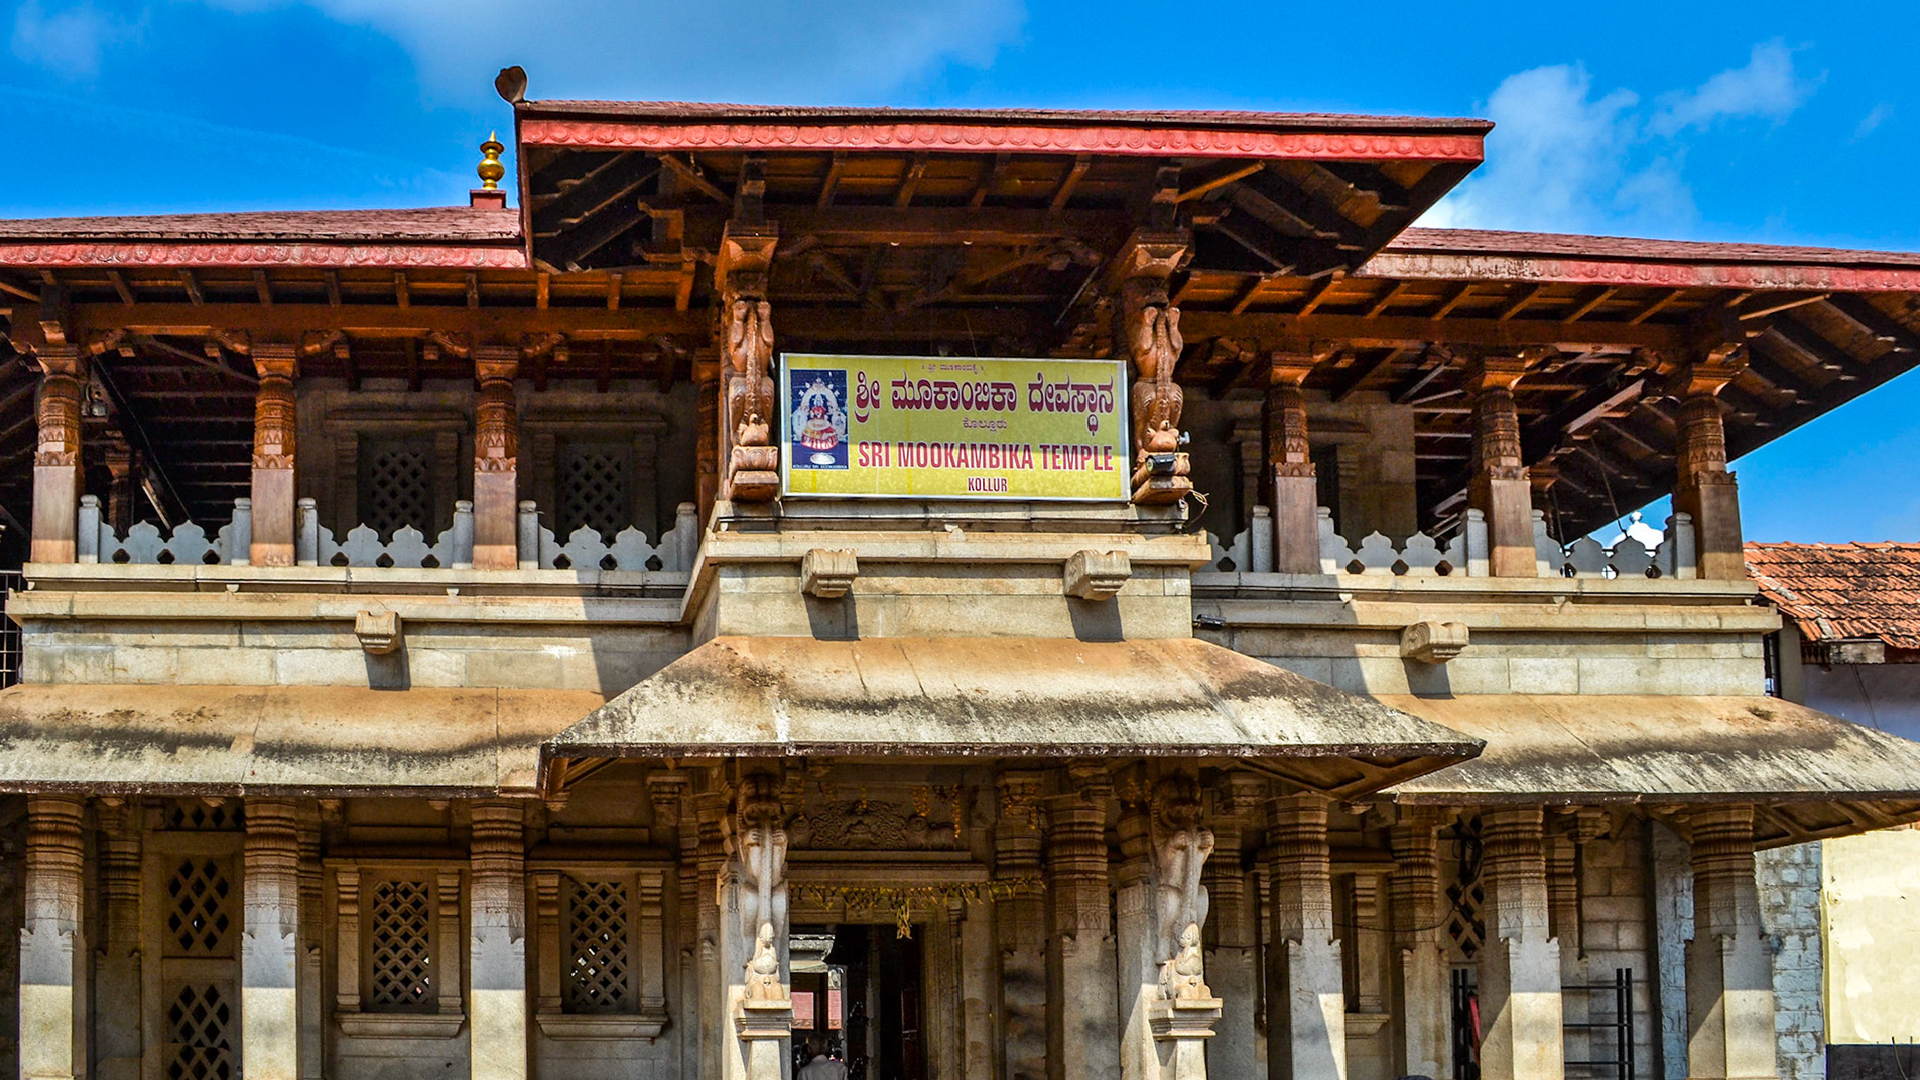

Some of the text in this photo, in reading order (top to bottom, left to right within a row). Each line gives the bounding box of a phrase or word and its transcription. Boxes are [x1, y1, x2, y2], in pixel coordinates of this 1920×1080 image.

[855, 369, 1114, 437] ಶ್ರೀ ಮೂಕಾಂಬಿಕಾ ದೇವಸ್ಥಾನ
[858, 441, 1114, 471] SRI MOOKAMBIKA TEMPLE
[968, 477, 1008, 492] KOLLUR
